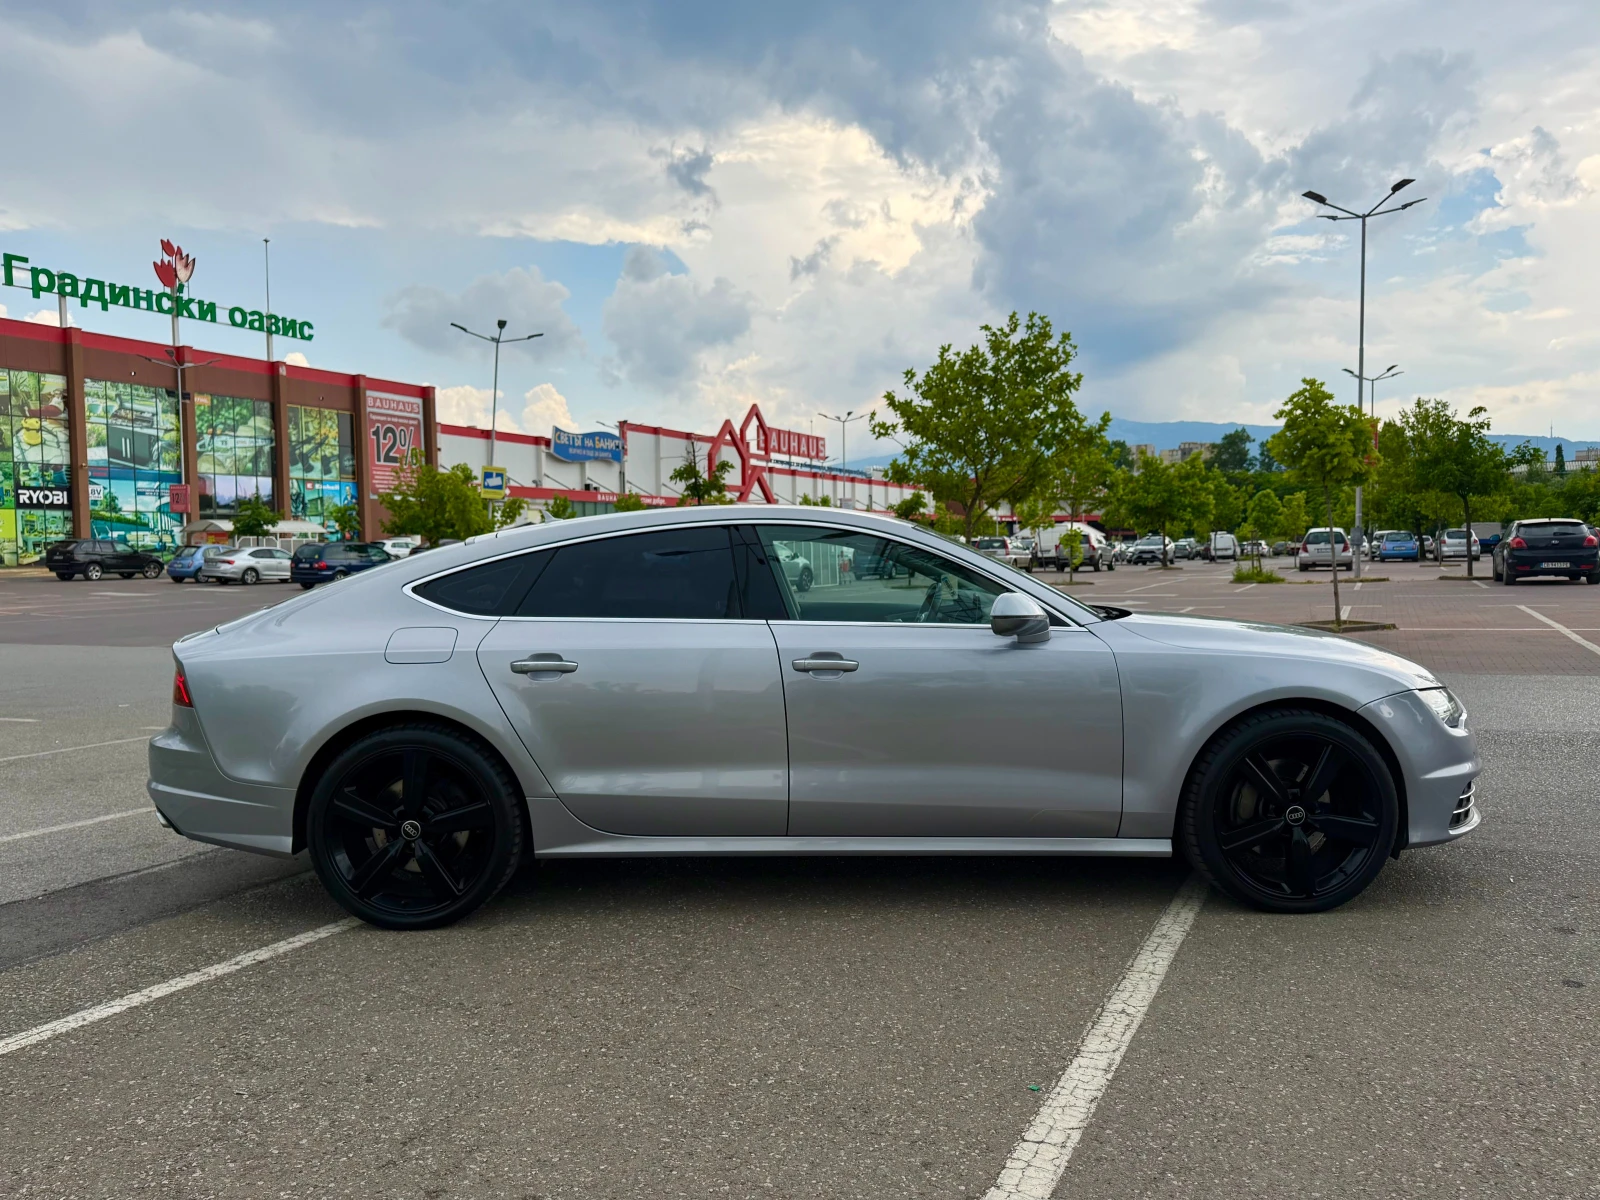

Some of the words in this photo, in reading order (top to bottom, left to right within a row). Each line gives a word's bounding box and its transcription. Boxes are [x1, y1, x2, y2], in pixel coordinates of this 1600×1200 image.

[2, 252, 217, 324] Градински
[228, 306, 314, 341] оазис
[367, 397, 419, 413] BAUHAUS
[370, 423, 420, 468] 12%
[585, 437, 594, 448] НА
[18, 489, 69, 505] RYOBI
[597, 494, 618, 502] BAUHA
